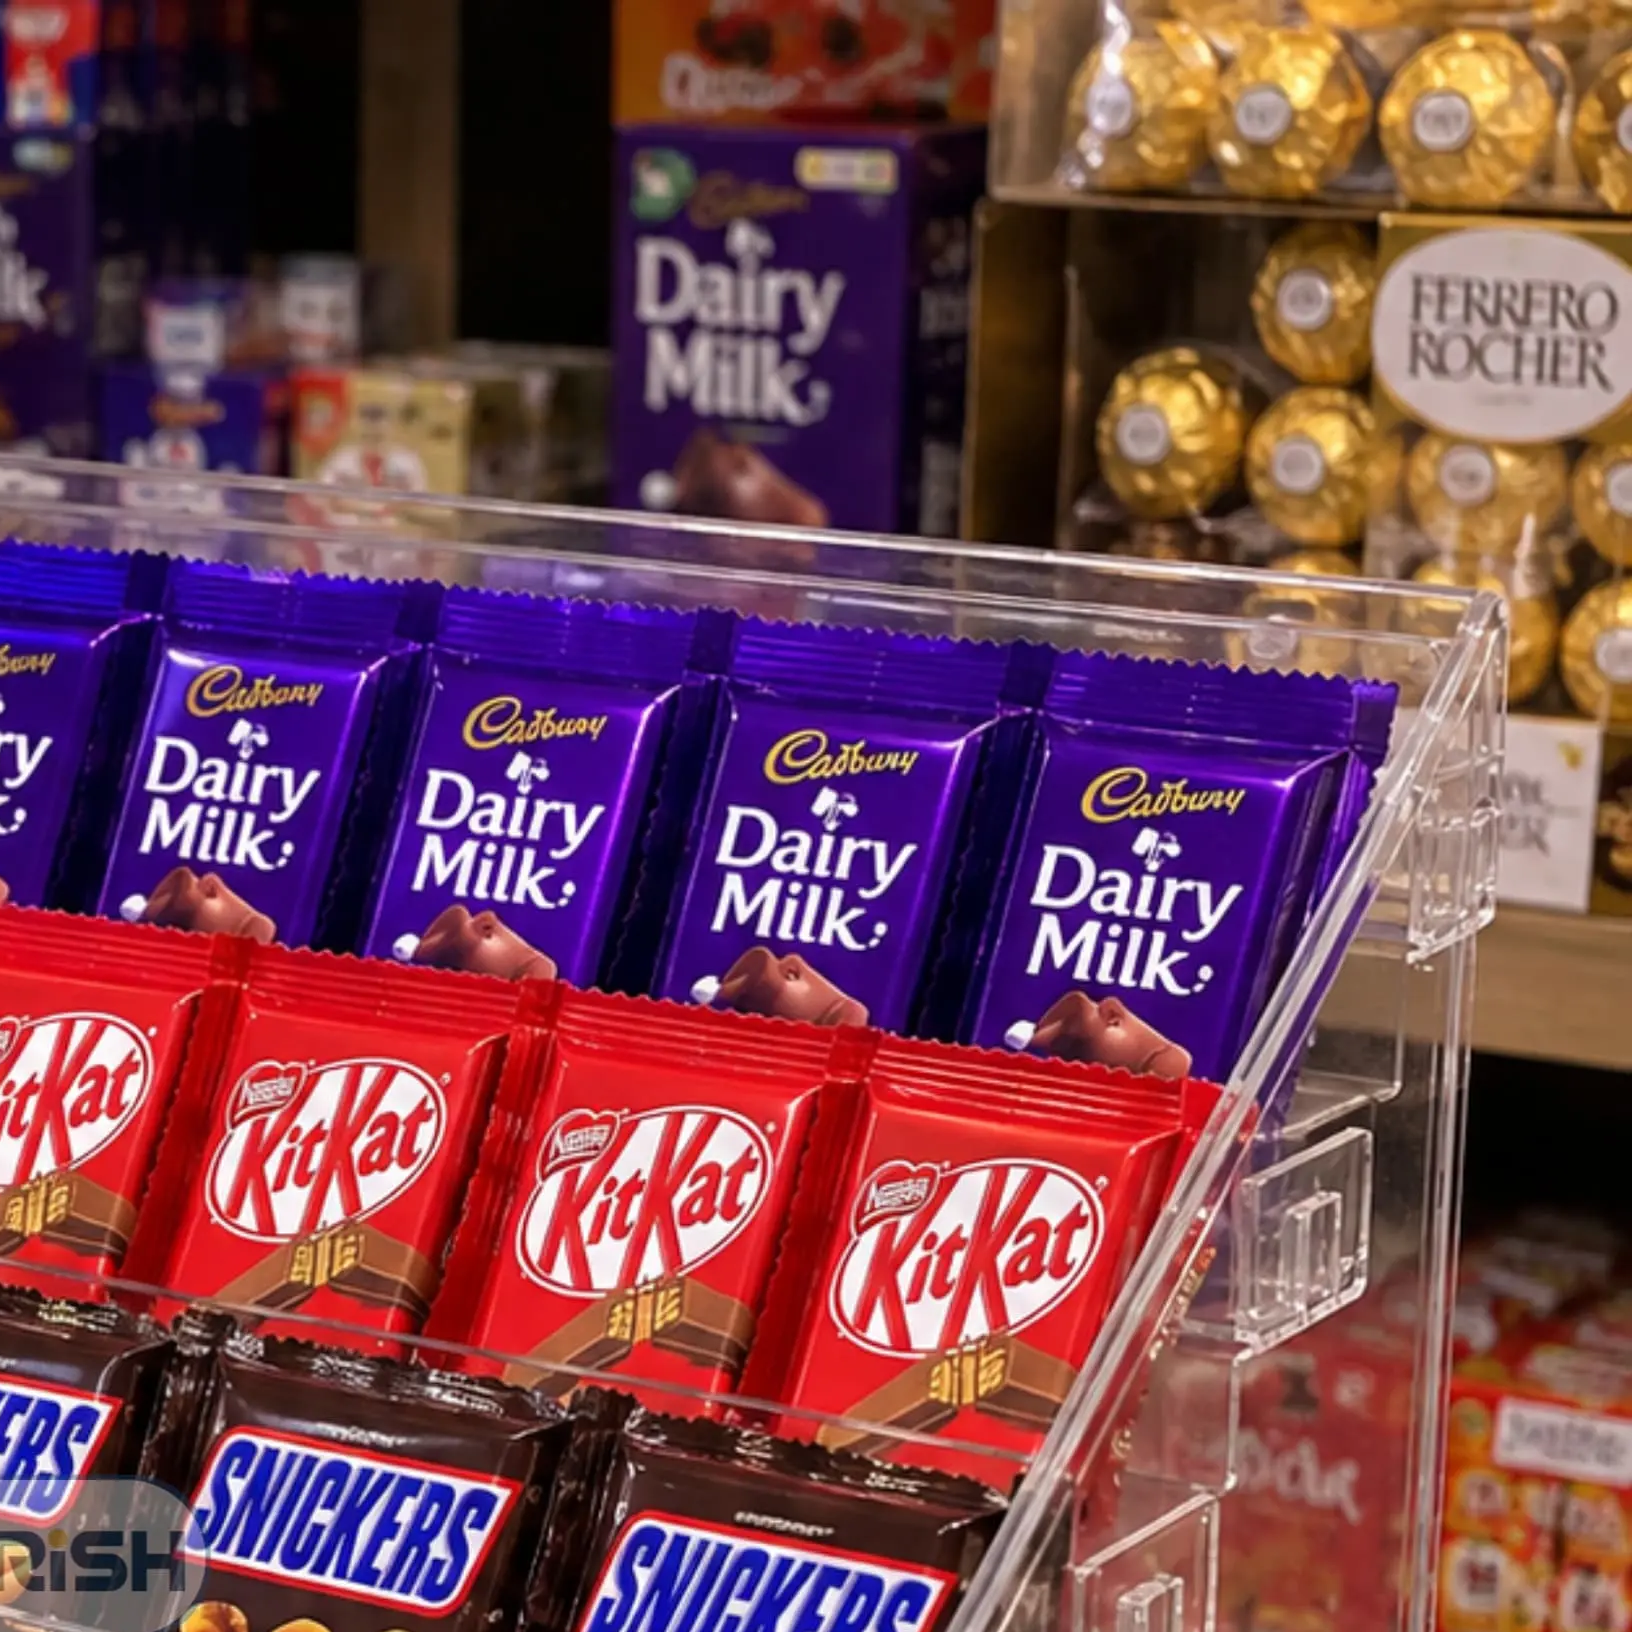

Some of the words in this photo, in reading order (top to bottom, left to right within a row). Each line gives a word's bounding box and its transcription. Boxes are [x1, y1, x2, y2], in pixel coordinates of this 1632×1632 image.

[634, 235, 846, 356] Dairy
[1409, 272, 1620, 337] FERRERO
[643, 327, 831, 427] Milk
[1408, 324, 1615, 394] ROCHER
[144, 735, 321, 823] Dairy
[763, 729, 919, 785] Cadbury
[1081, 766, 1246, 824] Cadbury
[138, 799, 294, 871] Milk
[416, 768, 605, 860] Dairy
[715, 806, 917, 899] Dairy
[411, 834, 576, 909] Milk
[711, 873, 887, 952] Milk
[1030, 844, 1243, 942] Dairy
[1026, 913, 1213, 996] Milk
[185, 1442, 499, 1606] SNICKERS
